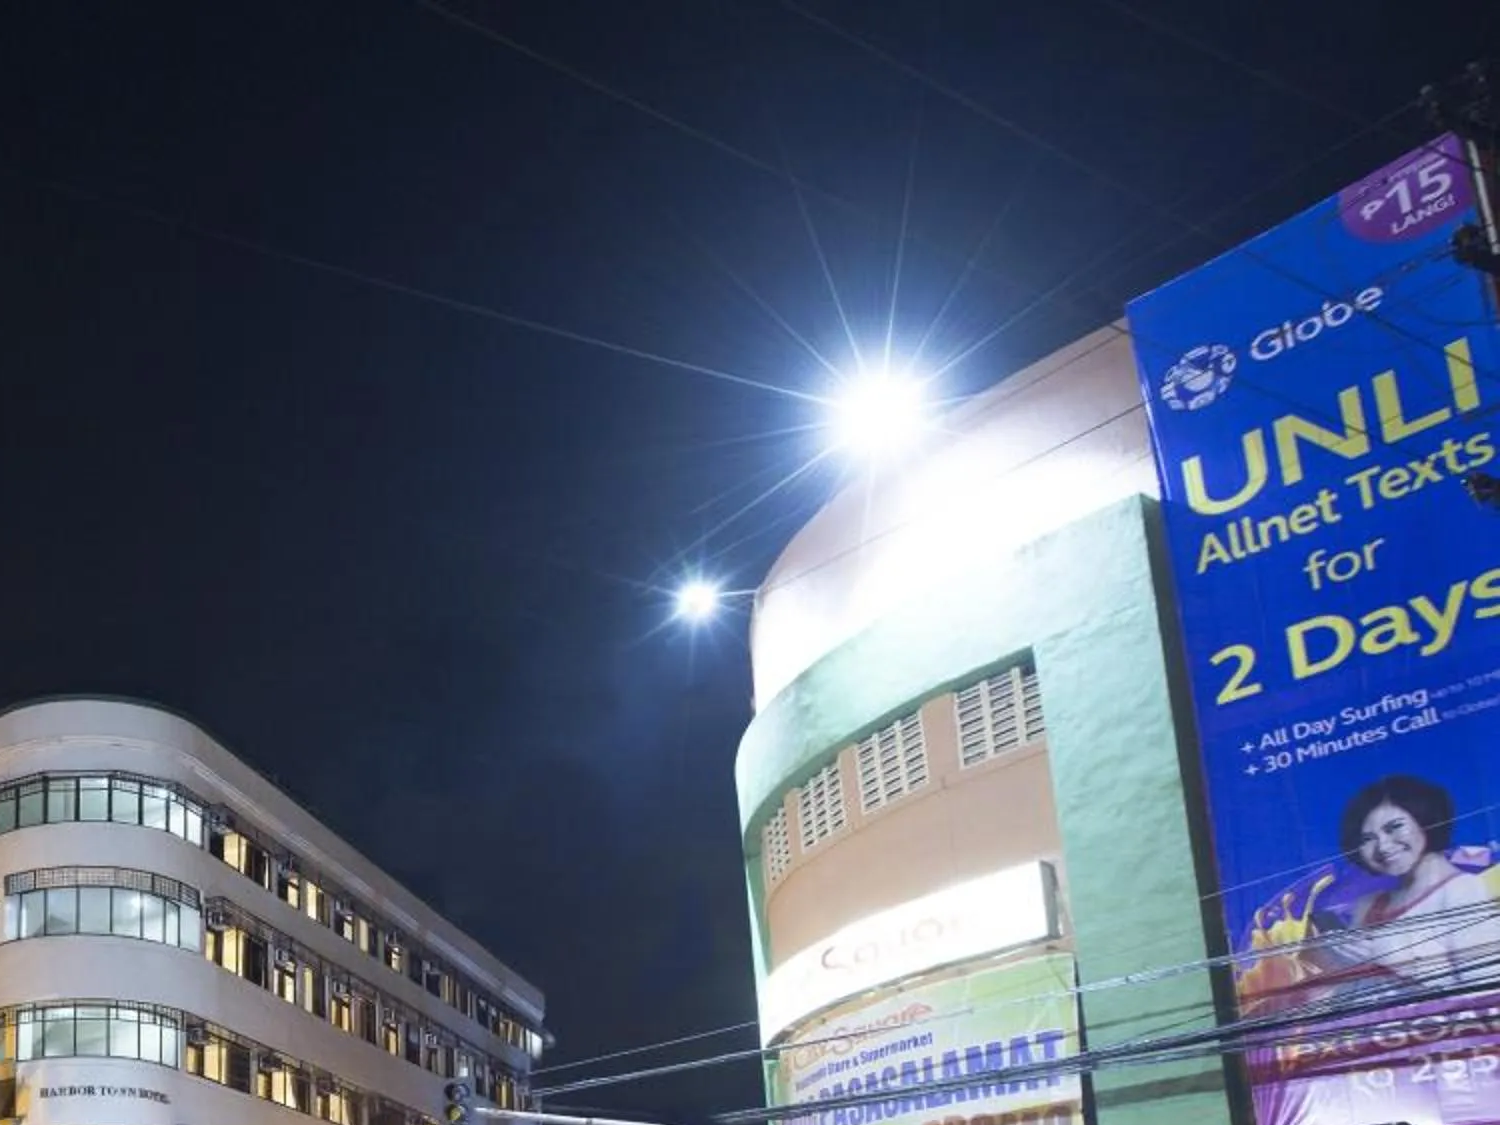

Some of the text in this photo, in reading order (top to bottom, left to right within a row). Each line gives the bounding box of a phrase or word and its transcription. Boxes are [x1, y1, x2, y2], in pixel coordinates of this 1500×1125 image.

[1250, 285, 1384, 361] Globe
[1180, 336, 1480, 516] UNLI
[1196, 432, 1495, 574] Allnet Texts
[1303, 537, 1385, 590] for
[1209, 566, 1500, 706] 2 Days
[1259, 727, 1290, 750] All
[1292, 715, 1337, 741] Day
[1340, 688, 1429, 726] Surfing
[1264, 752, 1293, 773] 30
[1296, 725, 1389, 764] Minutes
[1391, 706, 1442, 735] Call
[40, 1085, 95, 1099] HARBOR
